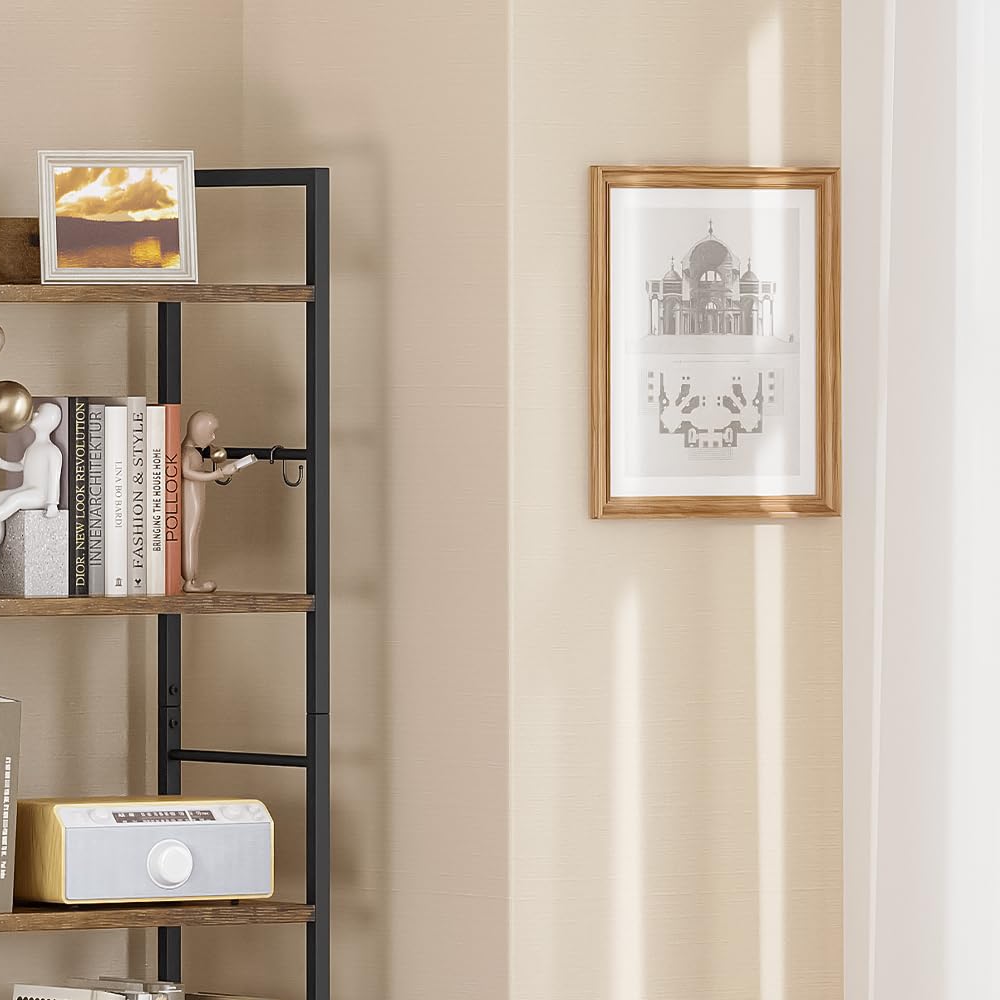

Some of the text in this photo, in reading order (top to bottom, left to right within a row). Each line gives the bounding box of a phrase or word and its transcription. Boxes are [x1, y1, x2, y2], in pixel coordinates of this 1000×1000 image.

[75, 402, 86, 586] DIOR. NEW LOOK REVOLUTION
[89, 411, 102, 566] INNENARCHITEKTUR
[115, 485, 122, 498] BO
[133, 412, 144, 568] FASHION & STYLE
[153, 448, 161, 552] BRINGING THE HOUSE HOME
[165, 453, 178, 542] POLLOCK
